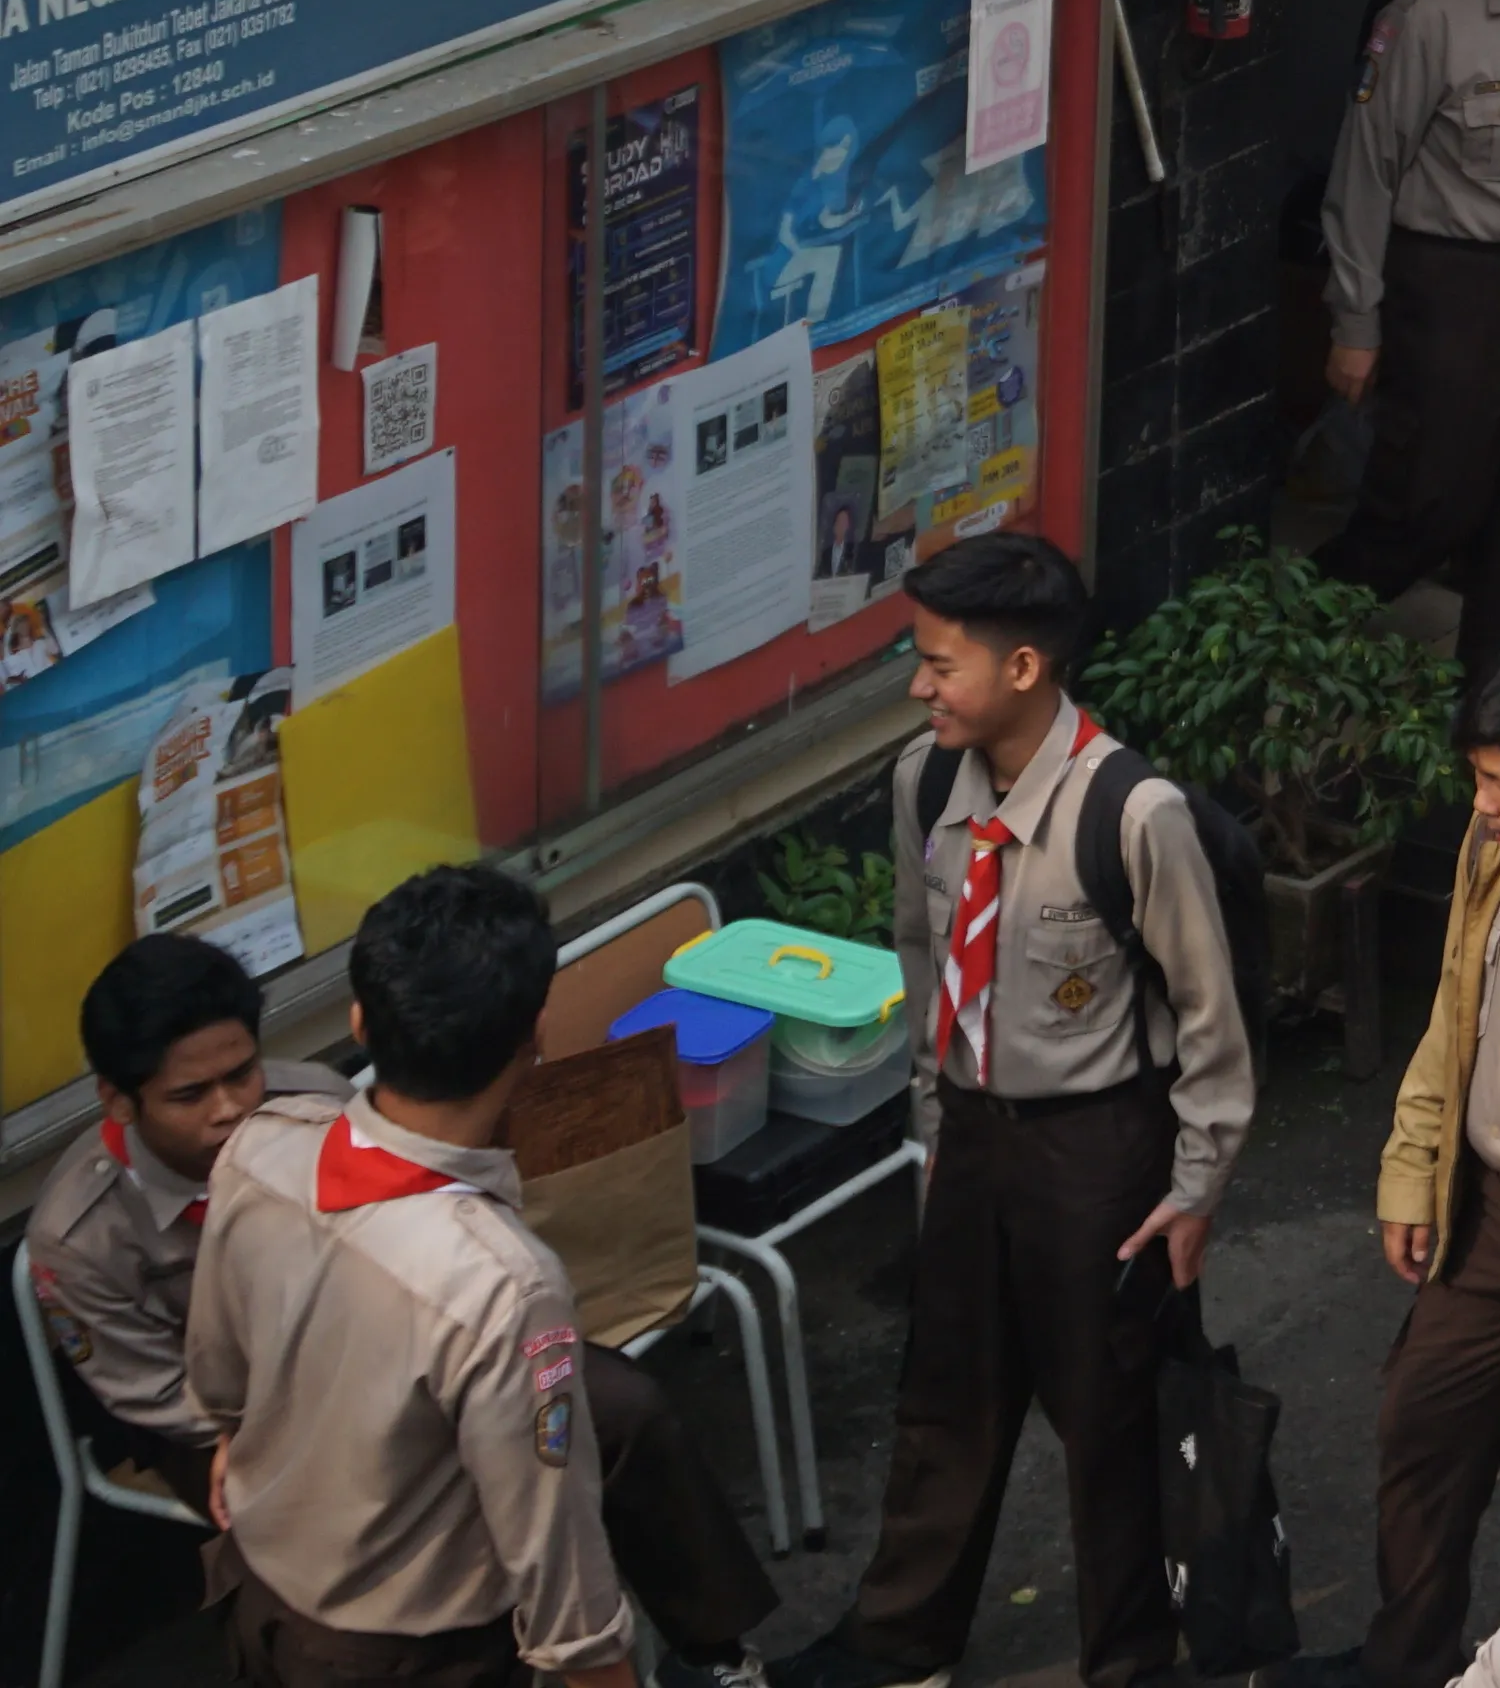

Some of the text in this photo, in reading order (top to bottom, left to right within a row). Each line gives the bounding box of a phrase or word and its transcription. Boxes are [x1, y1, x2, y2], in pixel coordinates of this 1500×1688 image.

[10, 57, 50, 92] Jalan
[52, 42, 100, 76] Taman
[103, 12, 169, 60] Bukitduri
[170, 3, 209, 37] Tebet
[33, 85, 65, 110] Telp
[75, 66, 112, 100] (021)
[176, 38, 201, 61] Fax
[204, 22, 238, 55] (021)
[13, 143, 67, 177] Email
[80, 69, 276, 153] info@sman8jkt.sch.id
[67, 100, 116, 133] Kode
[119, 88, 156, 113] Pos
[171, 59, 224, 95] 12840
